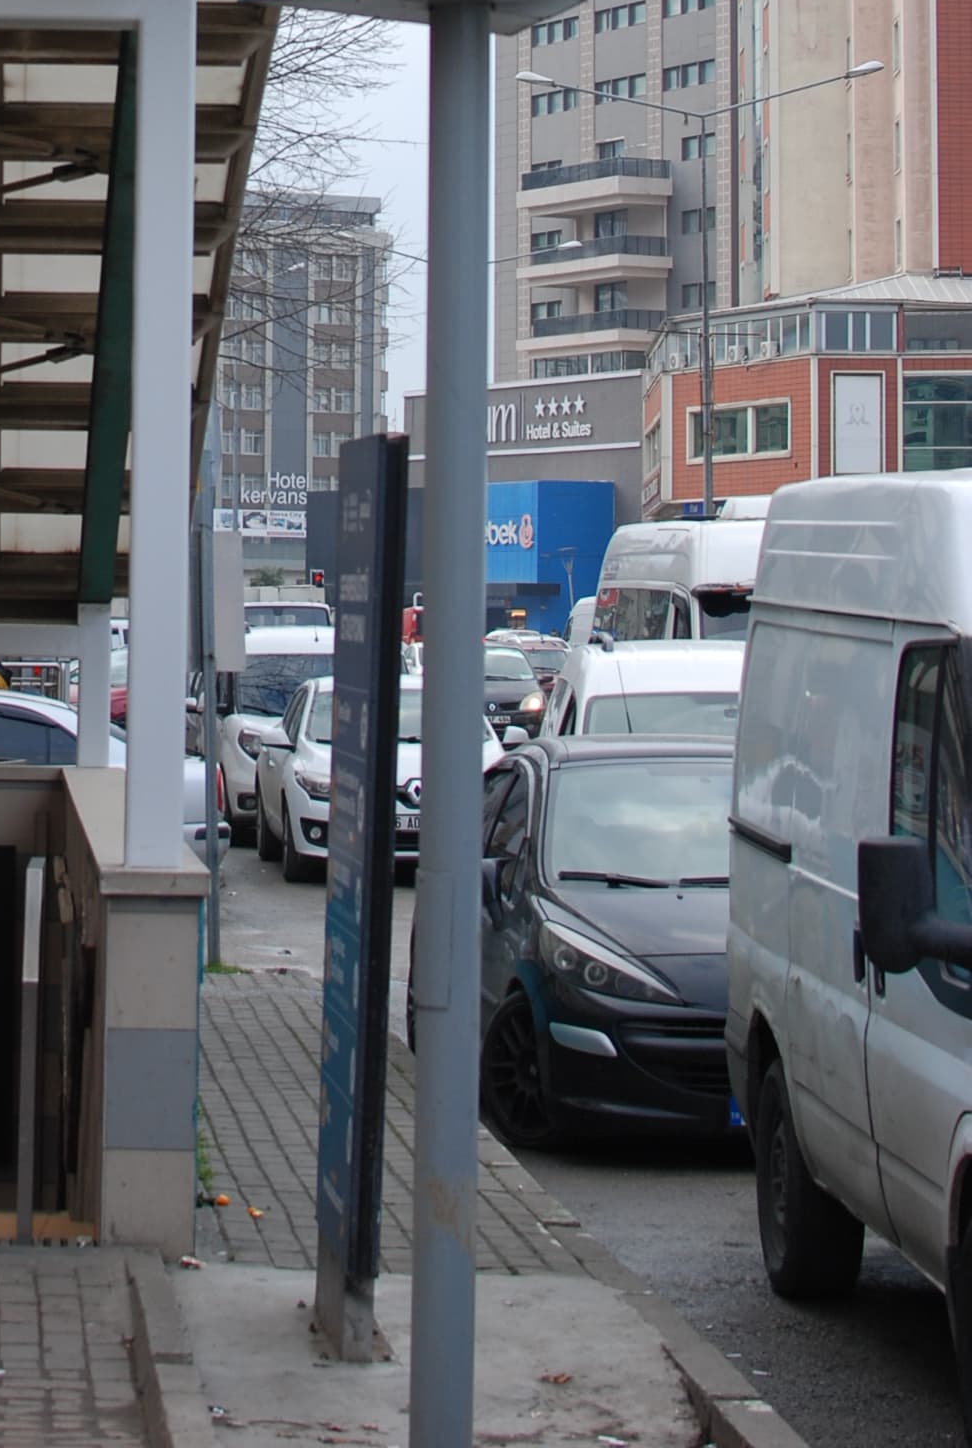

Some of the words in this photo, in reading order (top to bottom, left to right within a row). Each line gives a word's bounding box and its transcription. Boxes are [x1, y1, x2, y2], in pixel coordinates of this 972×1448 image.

[526, 423, 551, 441] Hotel
[552, 422, 560, 438] &
[561, 420, 592, 439] Suites
[267, 471, 310, 490] Hotel
